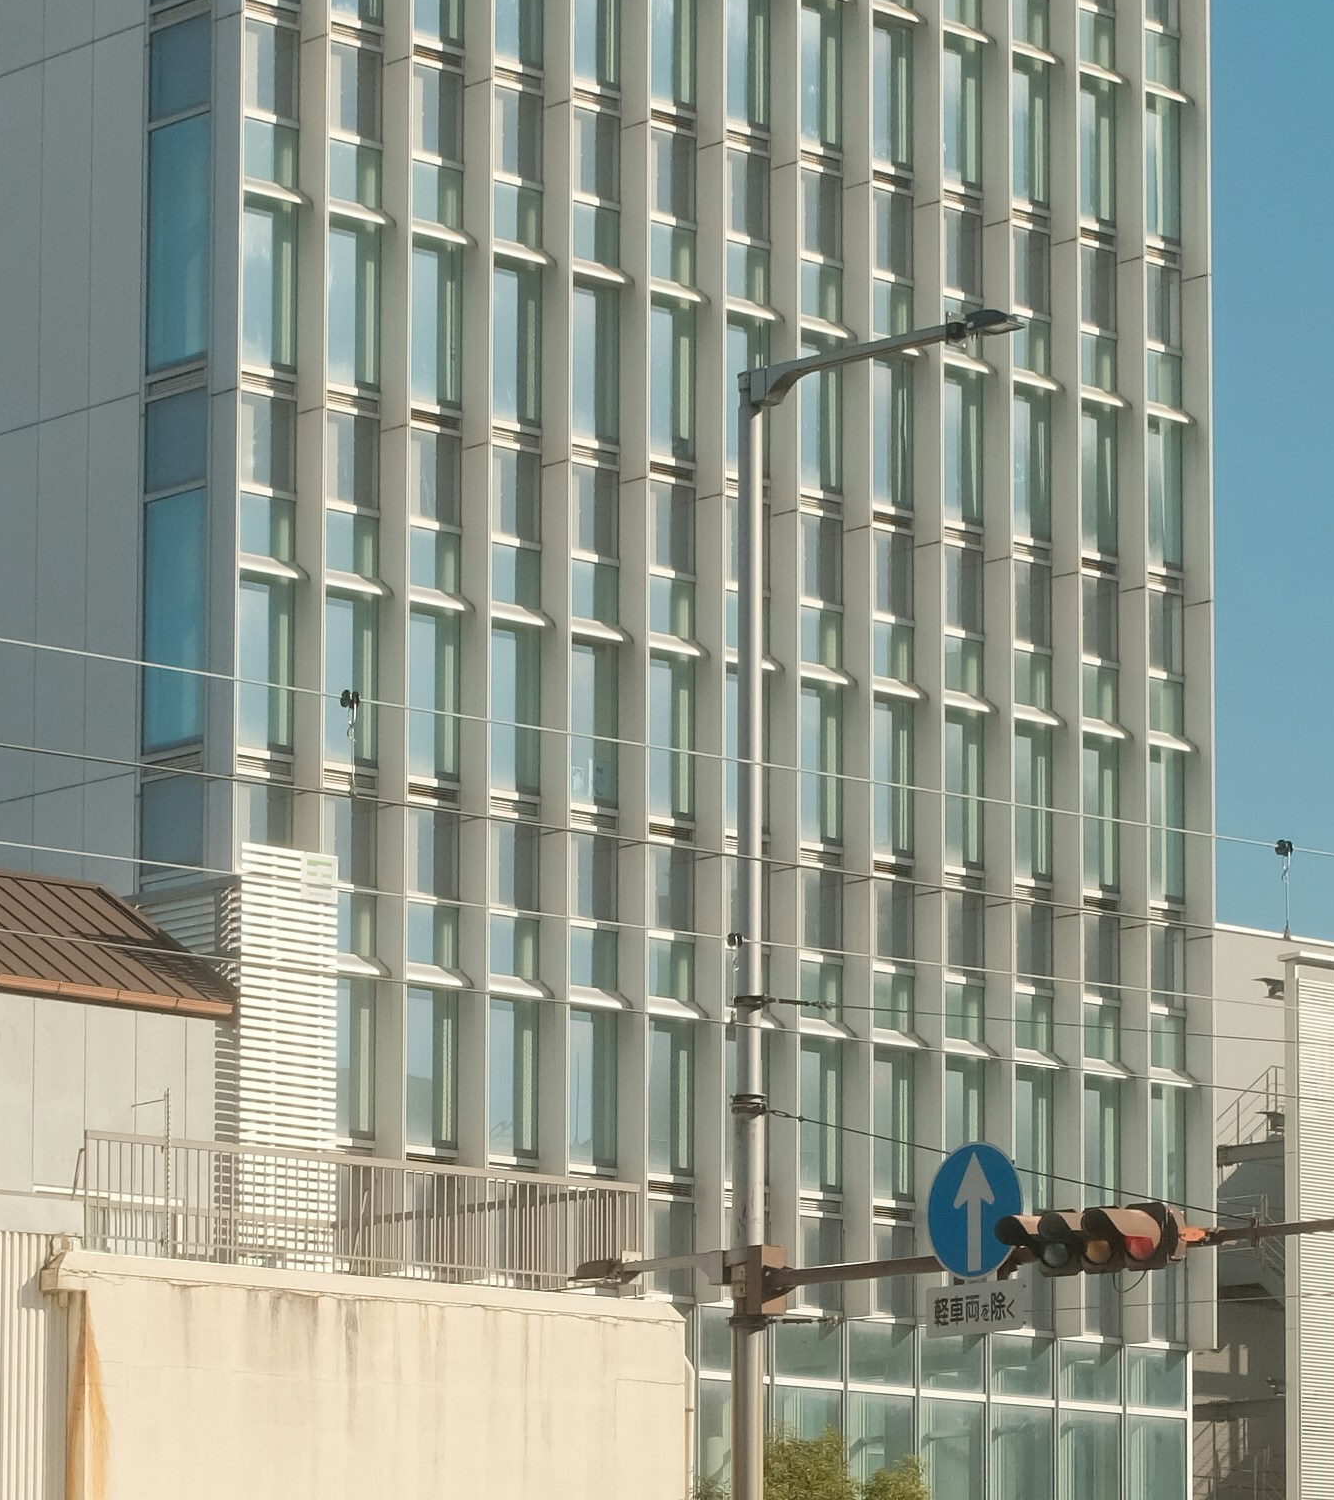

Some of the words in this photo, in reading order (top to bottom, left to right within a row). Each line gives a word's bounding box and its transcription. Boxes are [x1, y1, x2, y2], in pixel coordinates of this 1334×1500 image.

[933, 1290, 1016, 1328] 軽車両を除く
